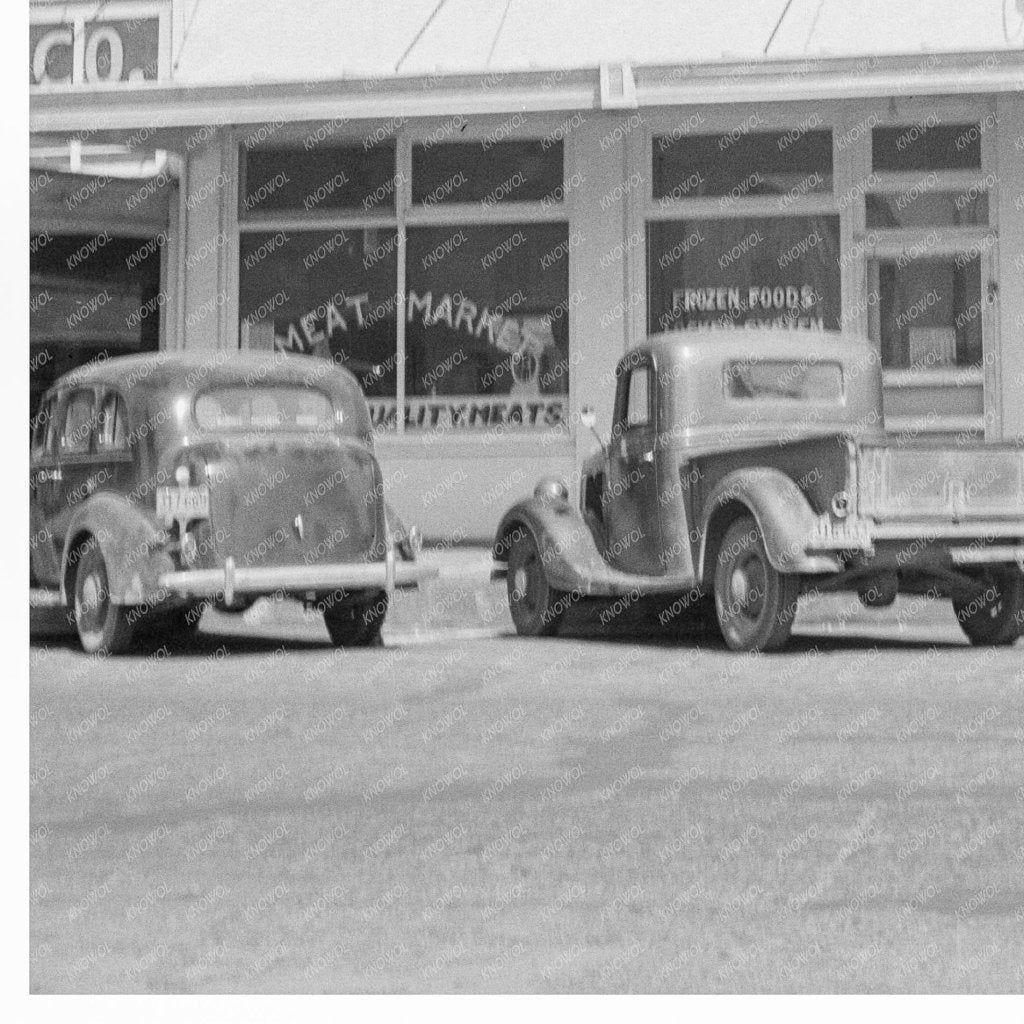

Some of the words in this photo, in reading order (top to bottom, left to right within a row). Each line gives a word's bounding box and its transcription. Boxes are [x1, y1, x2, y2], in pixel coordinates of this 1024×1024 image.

[672, 286, 740, 311] FROZEN
[748, 283, 814, 309] FOODS
[275, 292, 369, 356] MEAT
